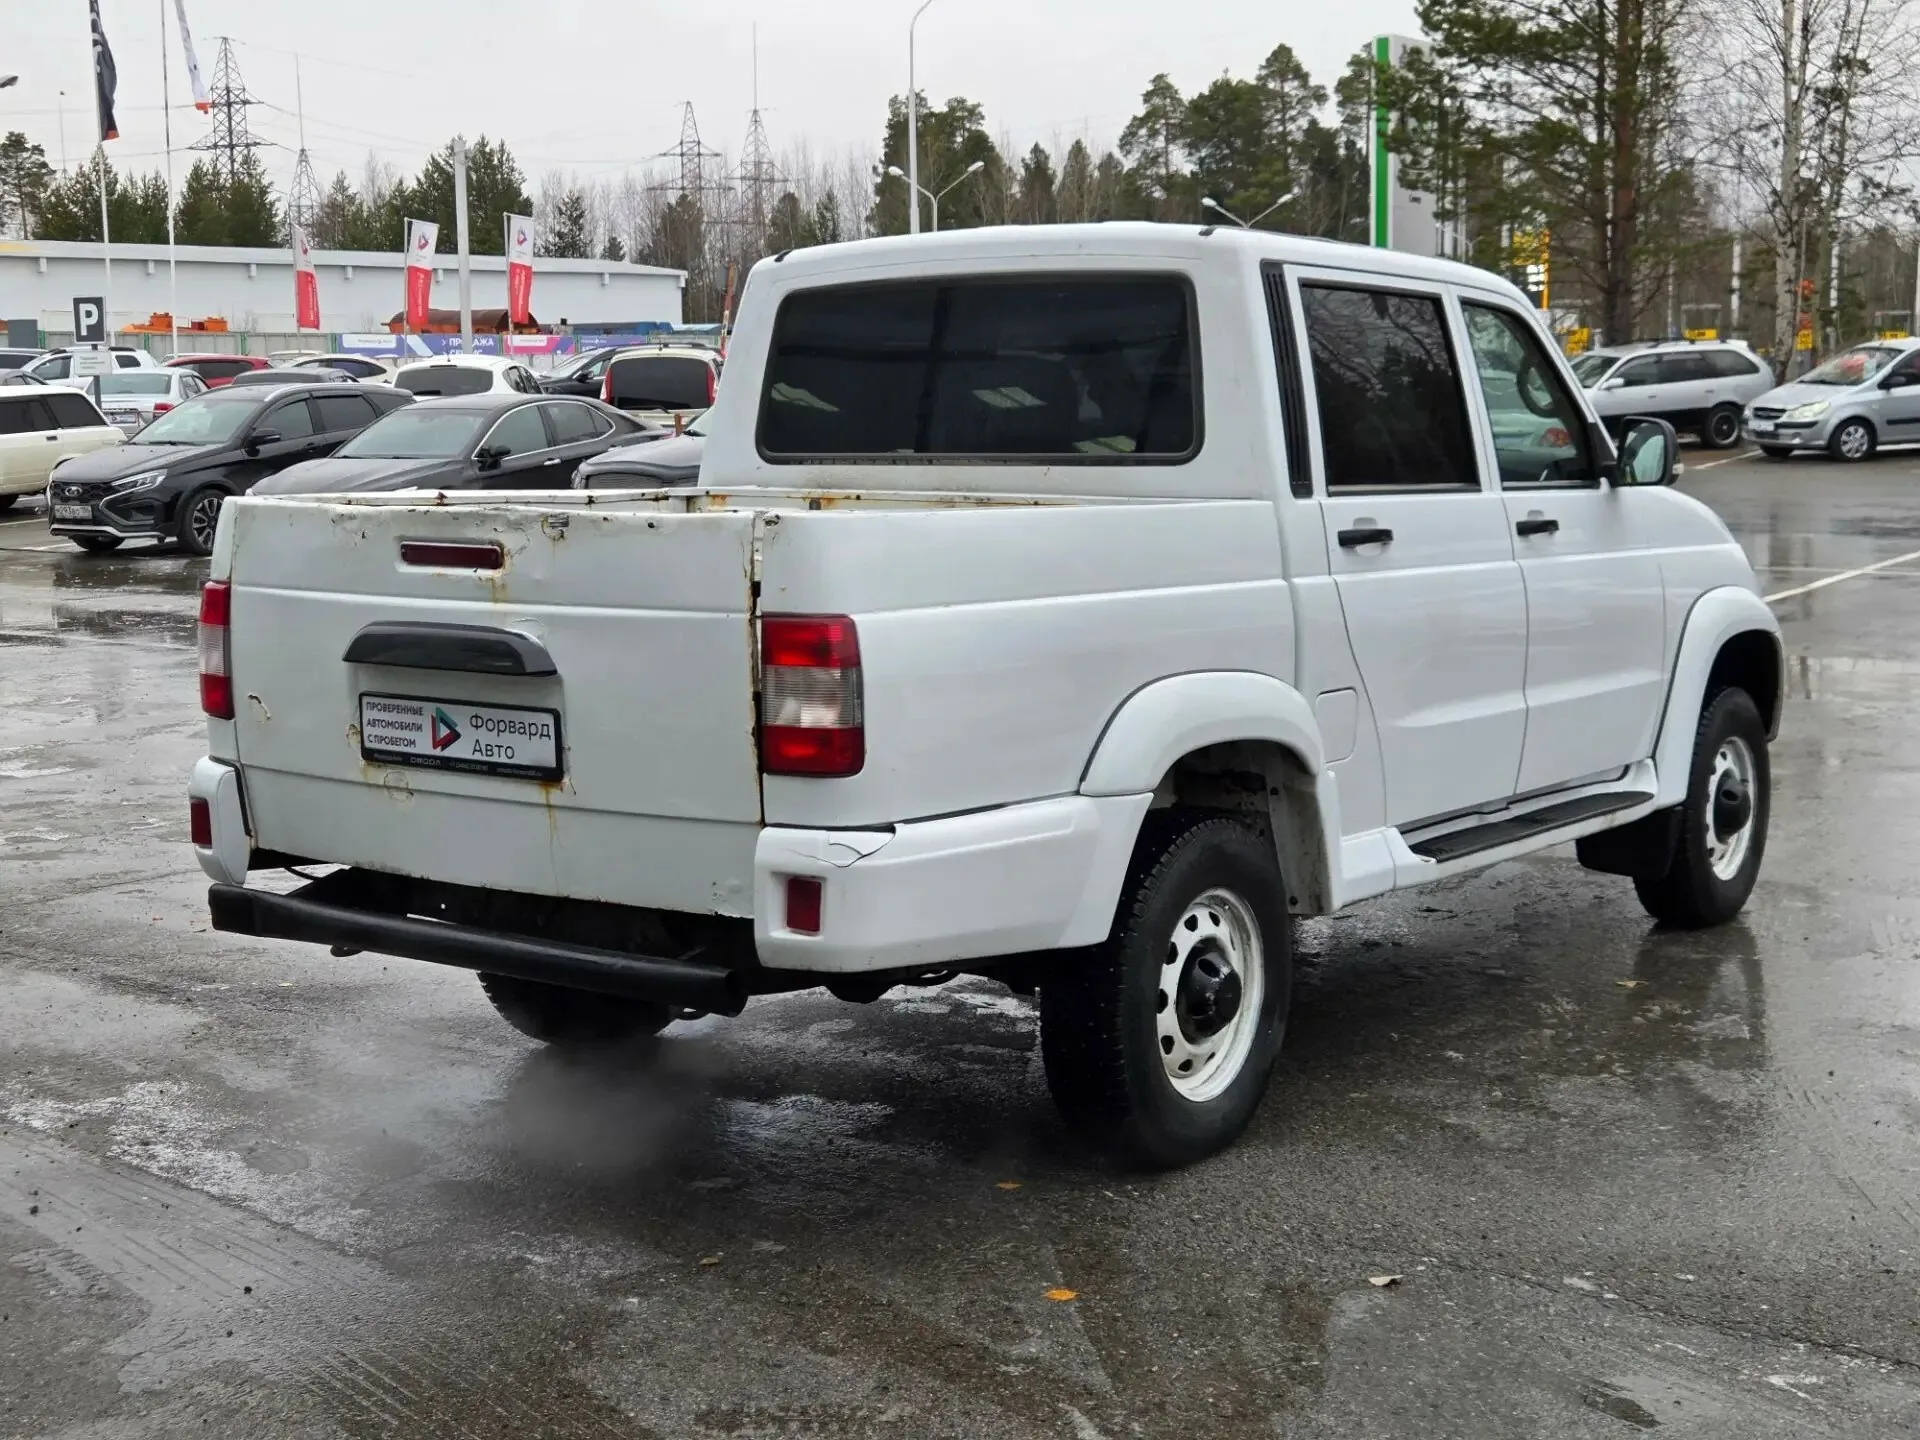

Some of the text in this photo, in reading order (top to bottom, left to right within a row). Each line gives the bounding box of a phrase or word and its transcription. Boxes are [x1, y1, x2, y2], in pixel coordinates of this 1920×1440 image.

[79, 303, 99, 336] P
[449, 338, 494, 347] ПРАЖА
[366, 702, 424, 716] ПРОВЕРЕННЫЕ
[366, 718, 423, 733] АВТОМОБИЛИ
[469, 712, 551, 741] Форвард
[367, 734, 416, 748] С ПРОБЕГОМ
[472, 739, 515, 760] Авто
